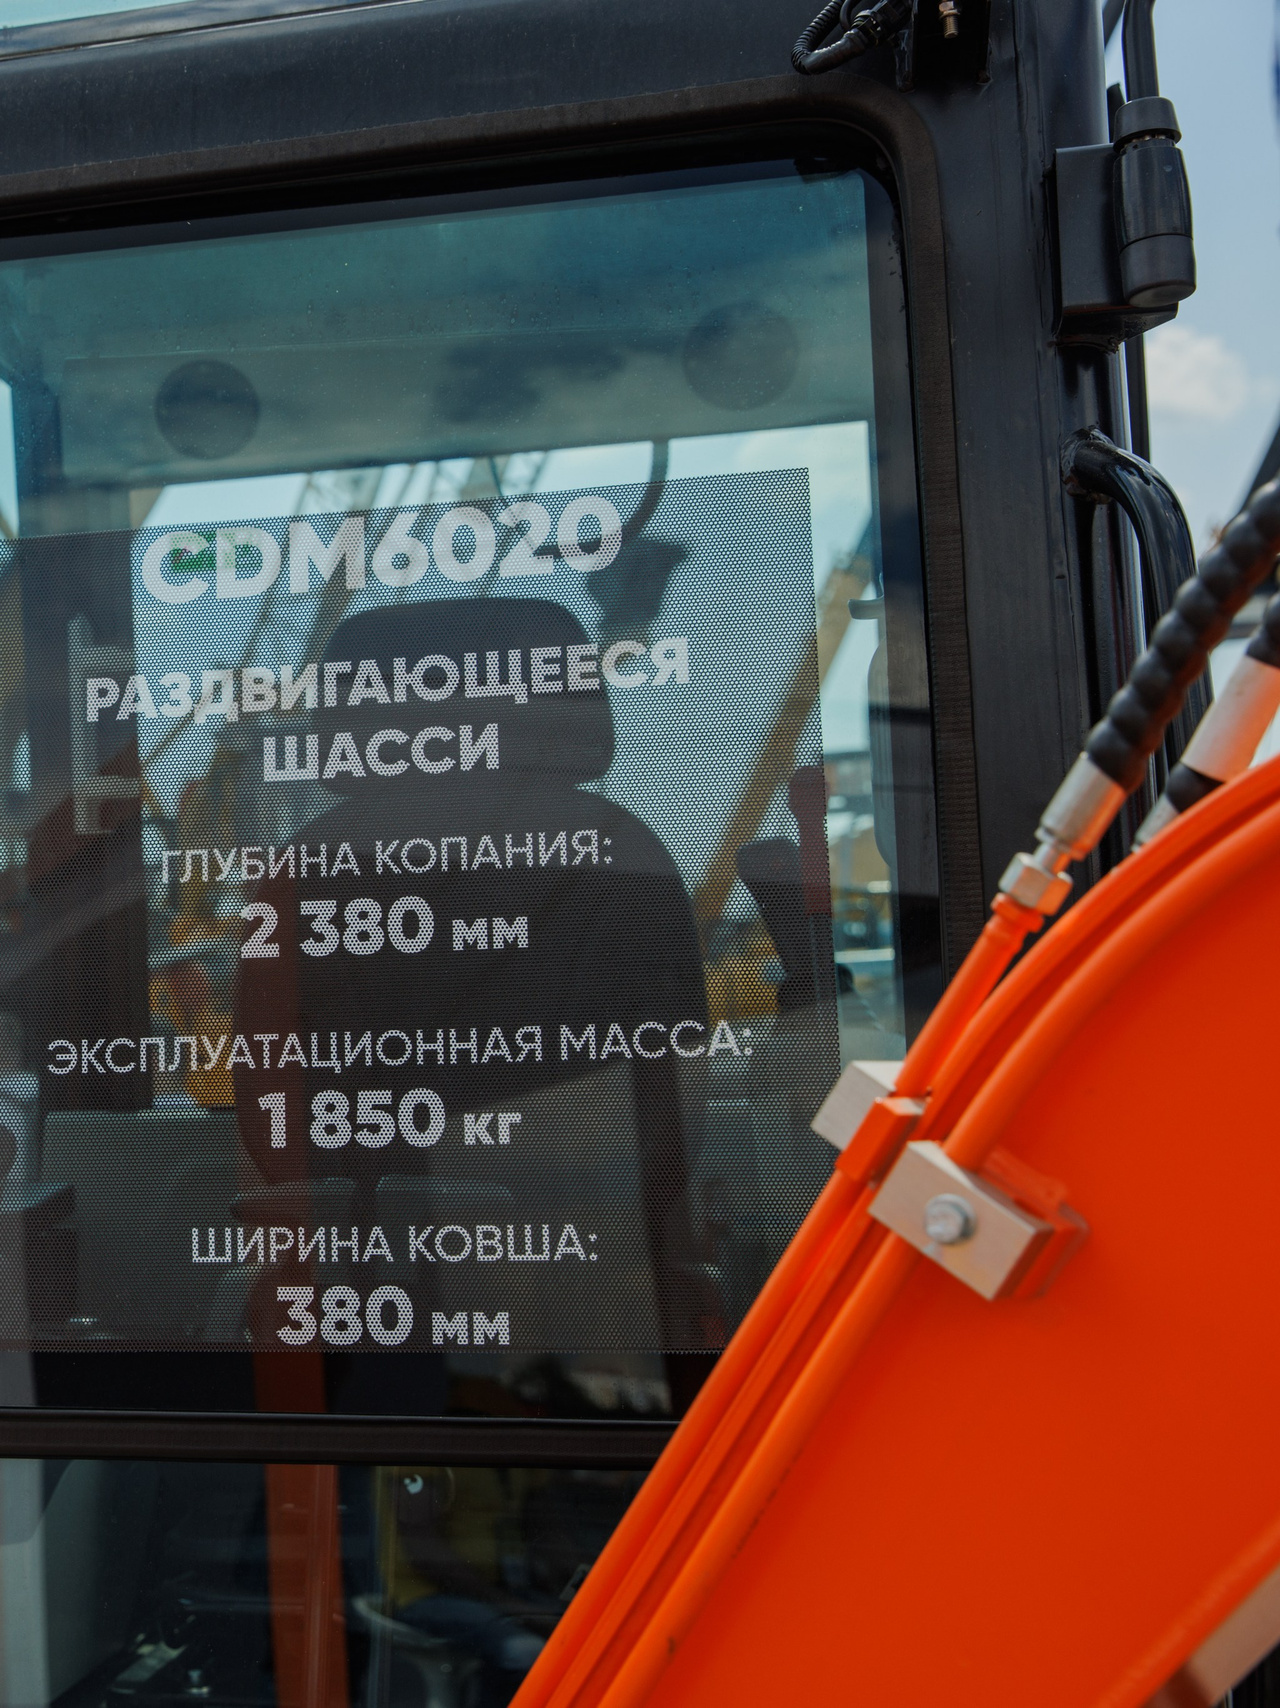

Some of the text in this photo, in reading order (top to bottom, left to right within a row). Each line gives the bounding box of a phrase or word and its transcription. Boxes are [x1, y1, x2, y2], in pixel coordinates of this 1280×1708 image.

[141, 496, 623, 604] CDM6020
[86, 637, 690, 724] РАЗДВИГАЮЩЕЕСЯ
[263, 722, 500, 783] ШАССИ
[160, 828, 614, 884] ГЛУБИНА КОПАНИЯ:
[239, 895, 529, 960] 2 380 мм
[46, 1019, 754, 1075] ЭКСПЛУАТАЦИОННАЯ МАССА:
[257, 1087, 522, 1149] 1 850 кг
[191, 1223, 599, 1264] ШИРИНА КОВША:
[275, 1284, 510, 1346] 380 мм
